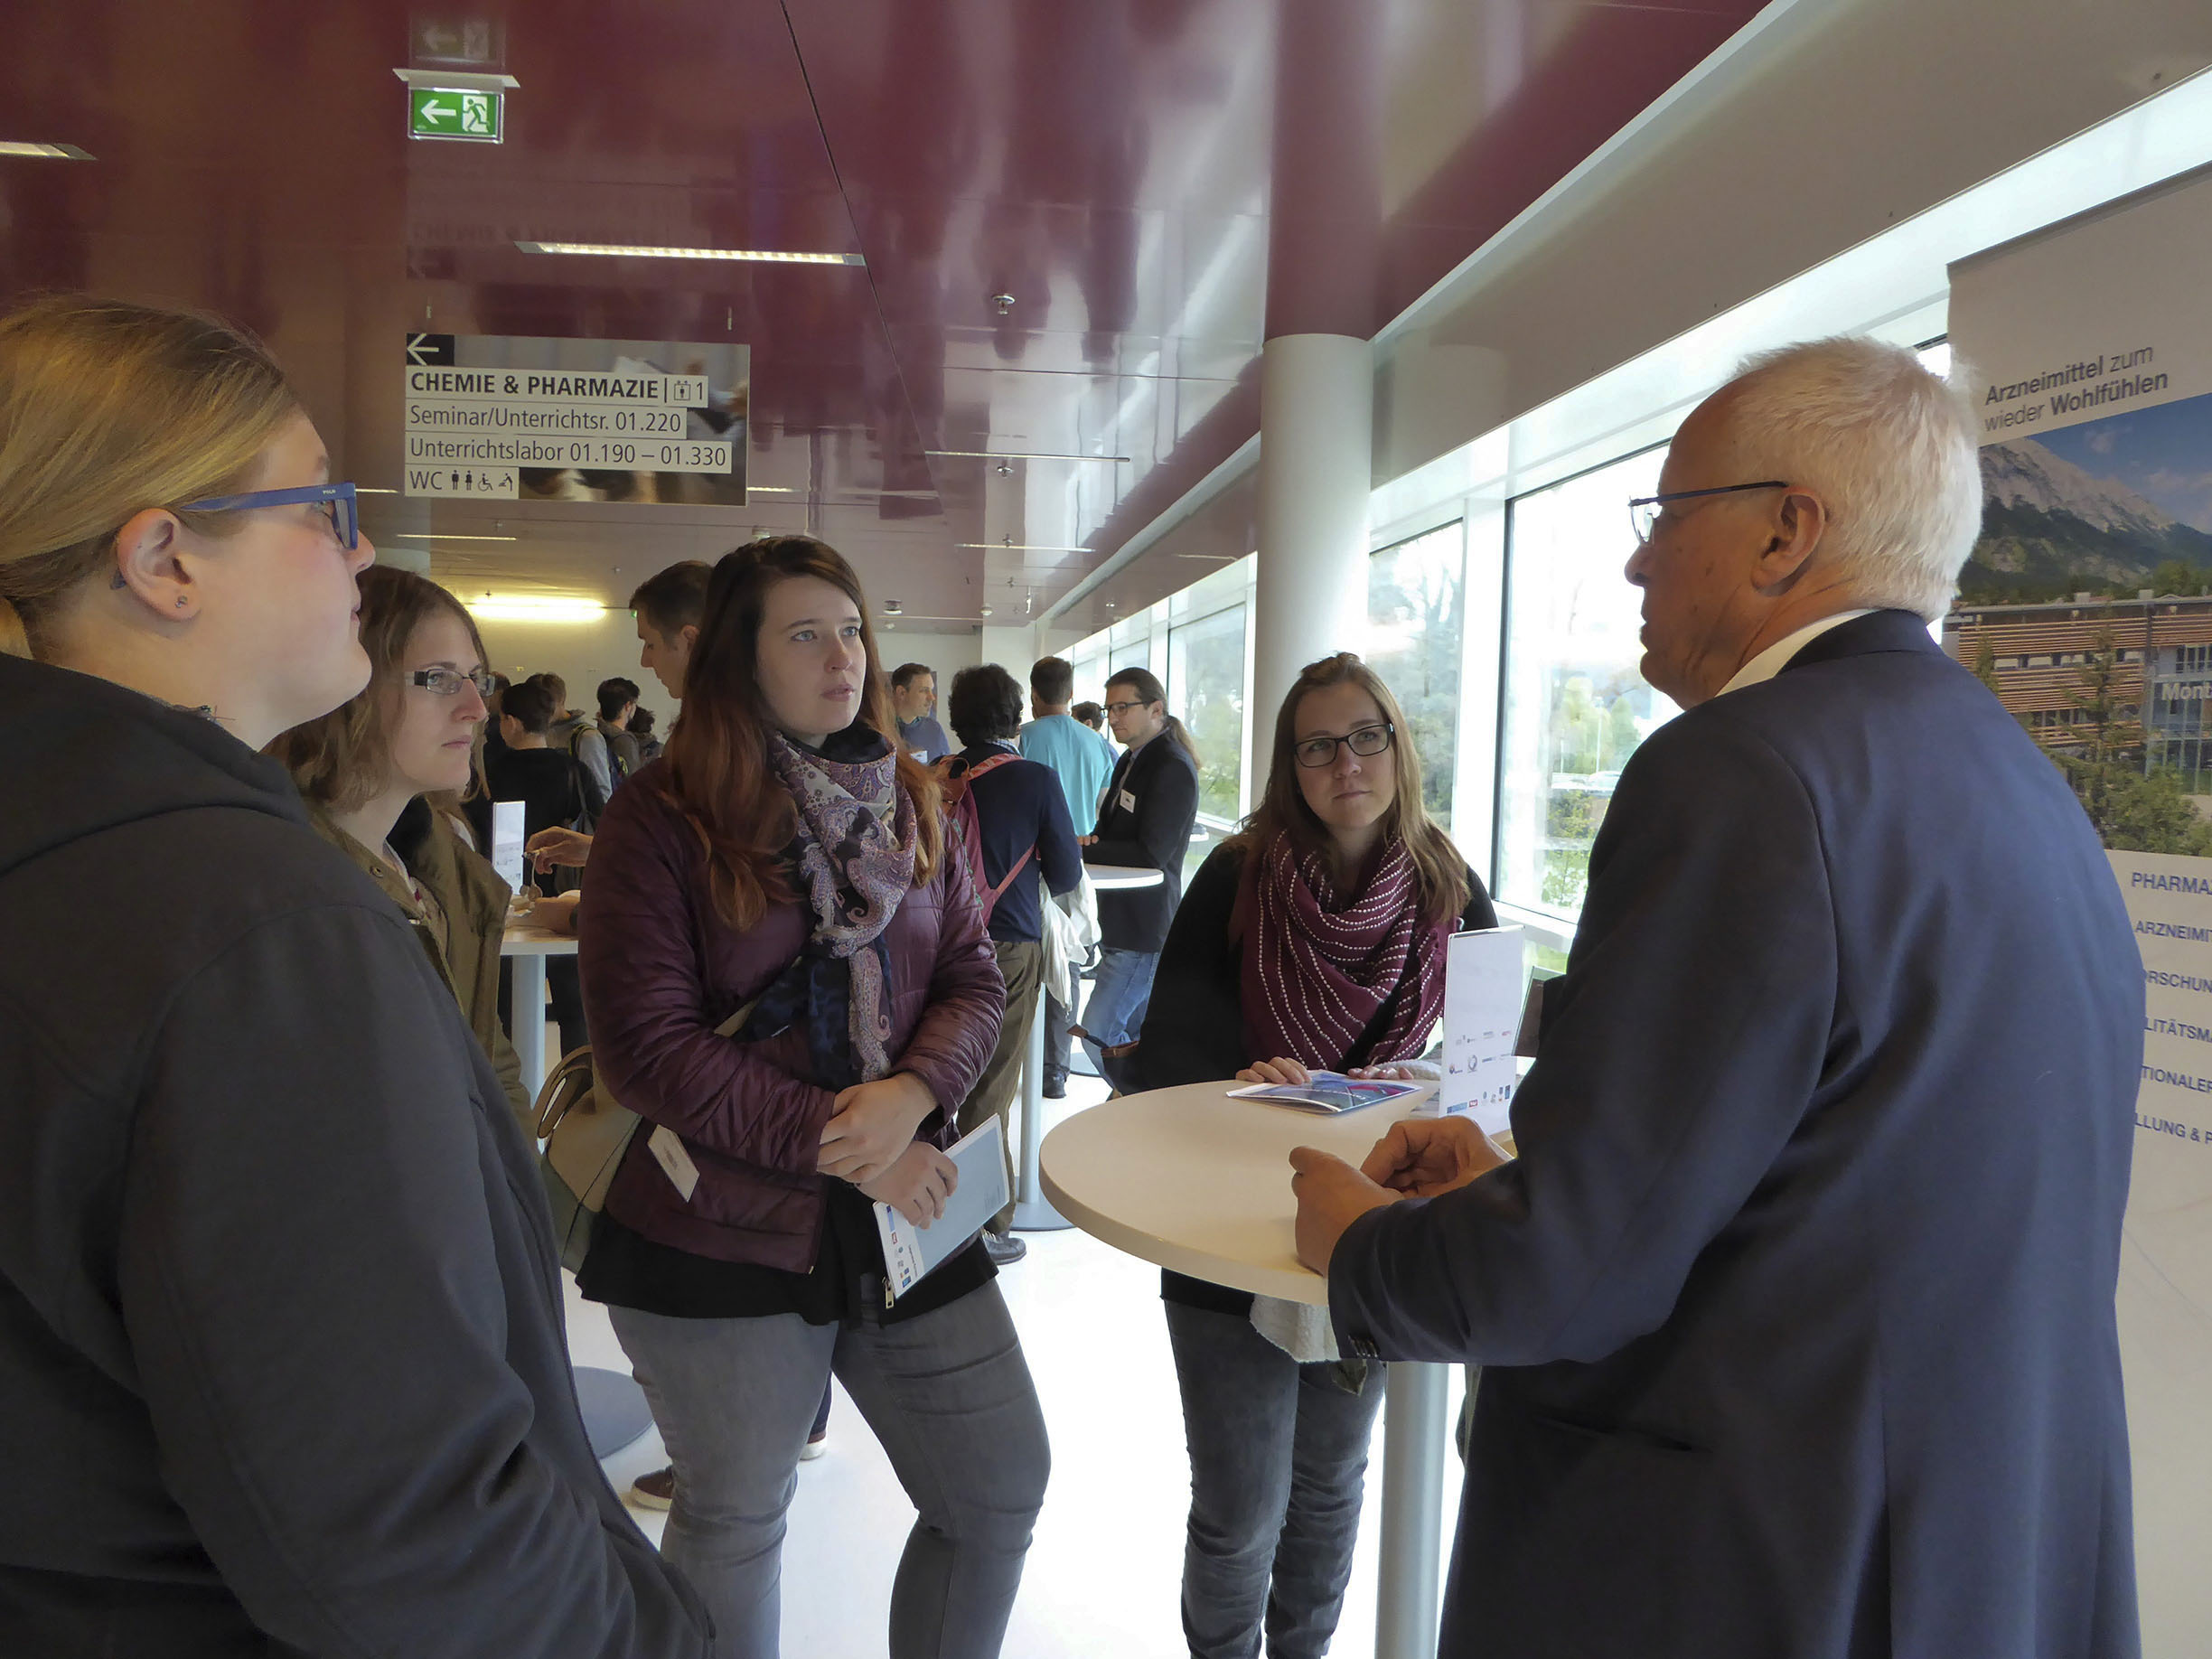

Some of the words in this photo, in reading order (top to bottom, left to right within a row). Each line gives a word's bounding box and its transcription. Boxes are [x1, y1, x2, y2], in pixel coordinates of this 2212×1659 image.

[410, 371, 496, 393] CHEMIE
[503, 375, 520, 395] &
[527, 375, 659, 399] PHARMAZIE
[696, 381, 703, 400] 1
[1984, 354, 2104, 406] Arzneimittel
[2110, 346, 2154, 373] zum
[1984, 404, 2046, 432] wieder
[2049, 372, 2169, 417] Wohlfühlen
[409, 405, 609, 430] Seminar/Unterrichtsr.
[615, 411, 681, 432] 01.220
[410, 437, 564, 462] Unterrichtslabor
[569, 442, 636, 464] 01.190
[661, 445, 726, 467] 01.330
[409, 470, 443, 491] WC
[2146, 970, 2212, 993] RSCHUN
[2190, 1127, 2201, 1143] &
